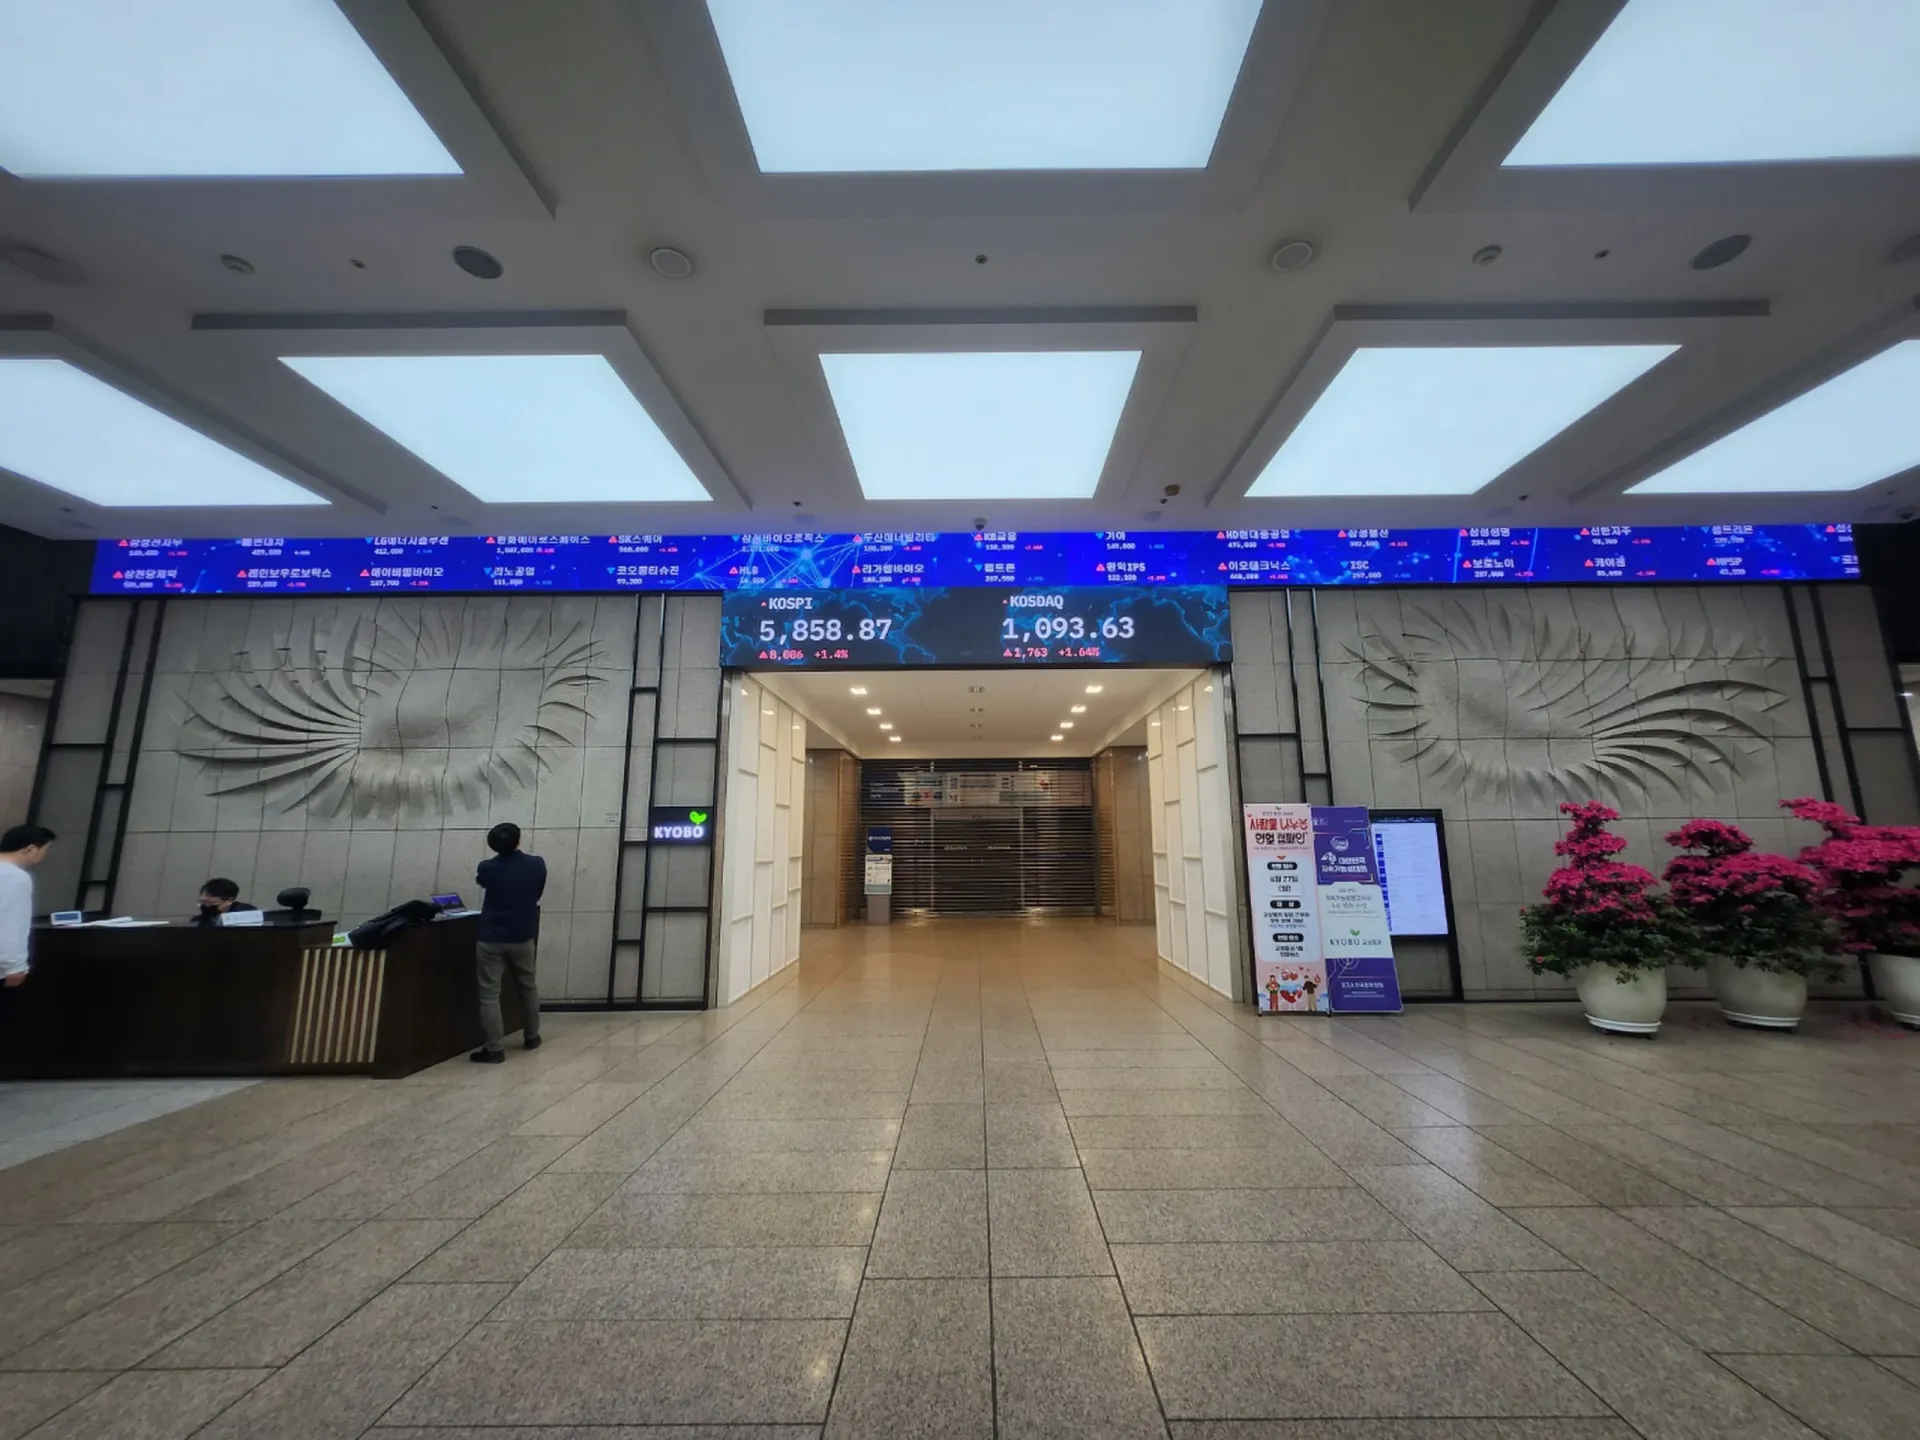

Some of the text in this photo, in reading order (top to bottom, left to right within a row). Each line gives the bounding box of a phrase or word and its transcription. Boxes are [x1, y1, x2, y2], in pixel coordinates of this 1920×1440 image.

[741, 533, 825, 544] 삼성바이오로직스
[863, 532, 935, 543] 두산에너빌리티
[1226, 529, 1290, 540] HD현대중공업
[374, 536, 449, 546] LG에너지솔루션
[1106, 562, 1146, 573] 원익IPS
[1228, 559, 1292, 571] 이오테크닉스
[1350, 560, 1369, 571] ISC
[1472, 557, 1515, 569] 보로노이
[247, 568, 332, 578] 레인보우로보틱스
[370, 566, 444, 577] 에이비엘바이오
[494, 566, 535, 577] 리노공업
[616, 565, 680, 576] 코오롱티슈진
[739, 565, 760, 576] HLB
[768, 597, 813, 611] KOSPI
[1010, 595, 1064, 610] KOSDAQ
[759, 618, 892, 646] 5,858.87
[1002, 616, 1135, 643] 1,093.63
[813, 649, 849, 660] +1.4%
[1013, 647, 1101, 660] 1,763 +1.64%
[654, 826, 704, 839] KYOBO
[1330, 938, 1360, 946] KYOBO
